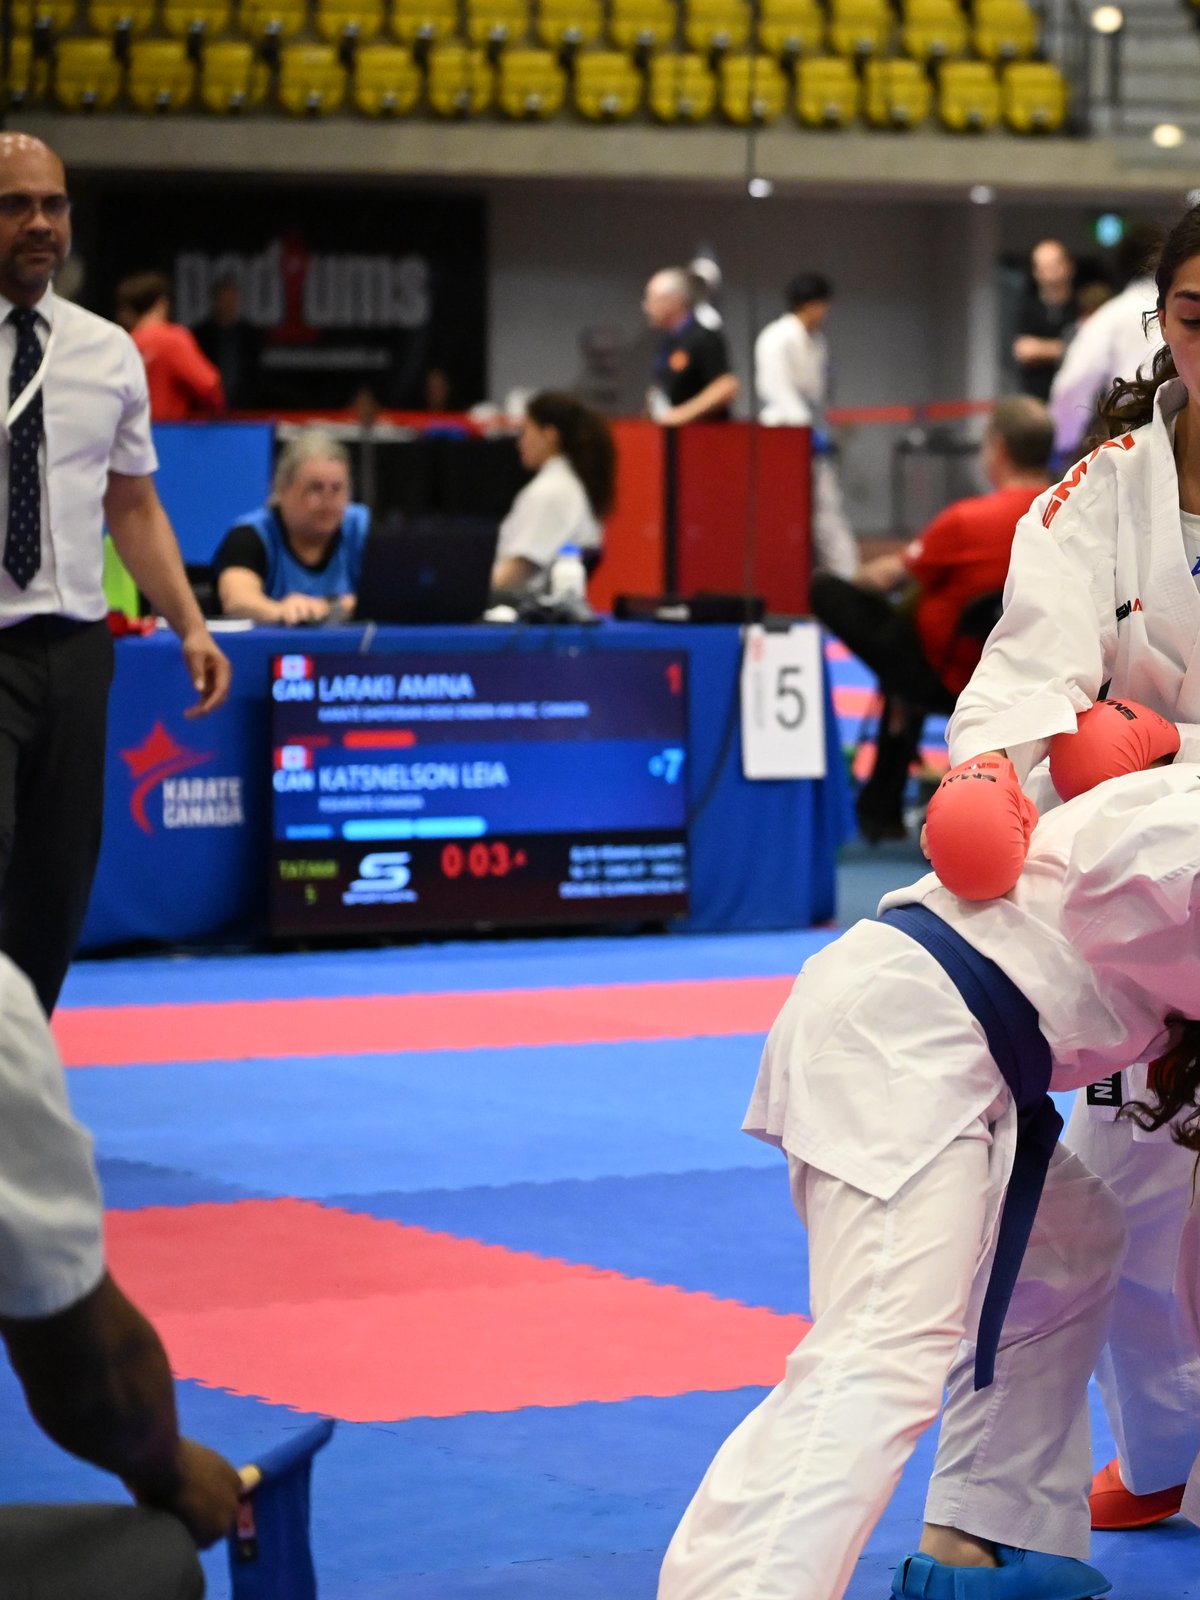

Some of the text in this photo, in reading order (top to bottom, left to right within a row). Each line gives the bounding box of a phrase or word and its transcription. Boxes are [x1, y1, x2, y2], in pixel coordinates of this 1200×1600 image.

[272, 673, 475, 702] CAN LARAKI AMINA
[666, 662, 682, 694] 1
[776, 666, 806, 730] 5
[163, 777, 242, 801] KARATE
[273, 769, 315, 792] CAN
[461, 761, 510, 788] LEIA
[163, 802, 244, 829] CANADA
